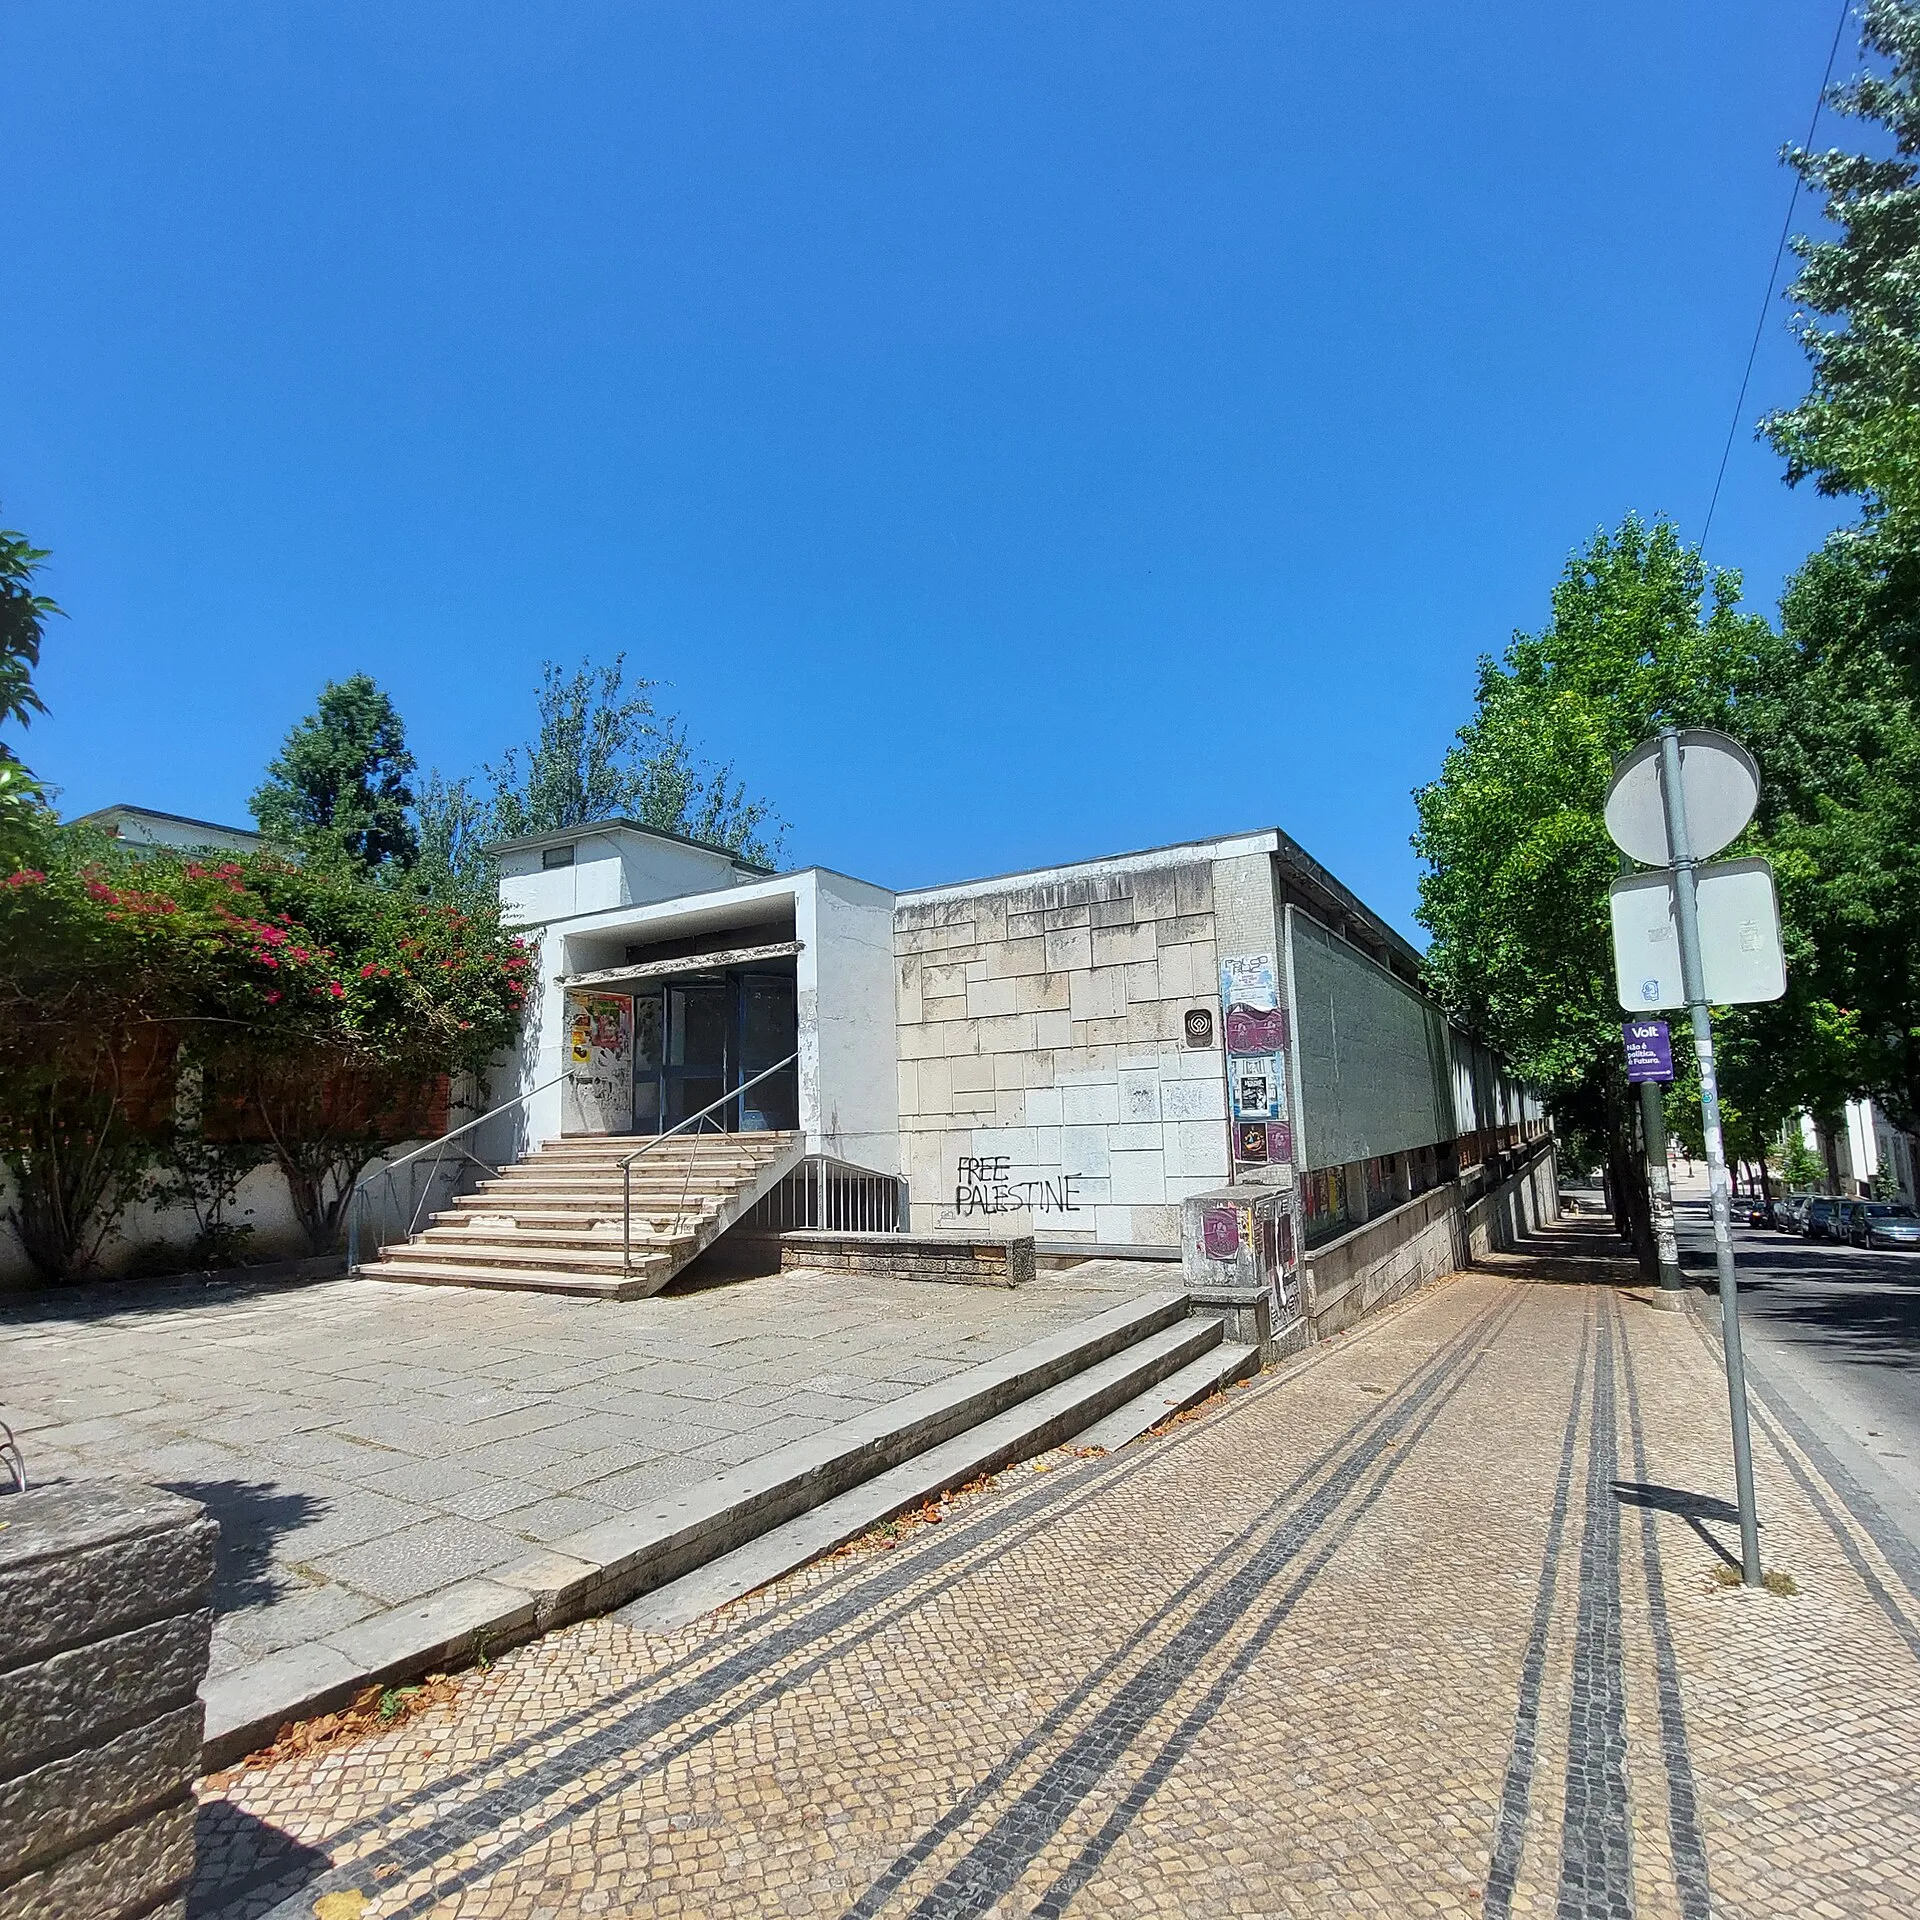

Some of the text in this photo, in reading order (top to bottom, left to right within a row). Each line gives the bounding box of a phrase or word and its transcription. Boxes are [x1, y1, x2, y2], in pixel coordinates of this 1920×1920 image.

[1631, 1026, 1659, 1038] Volt
[1626, 1043, 1641, 1051] Não
[957, 1156, 1010, 1185] FREE
[956, 1173, 1082, 1215] PALESTINE
